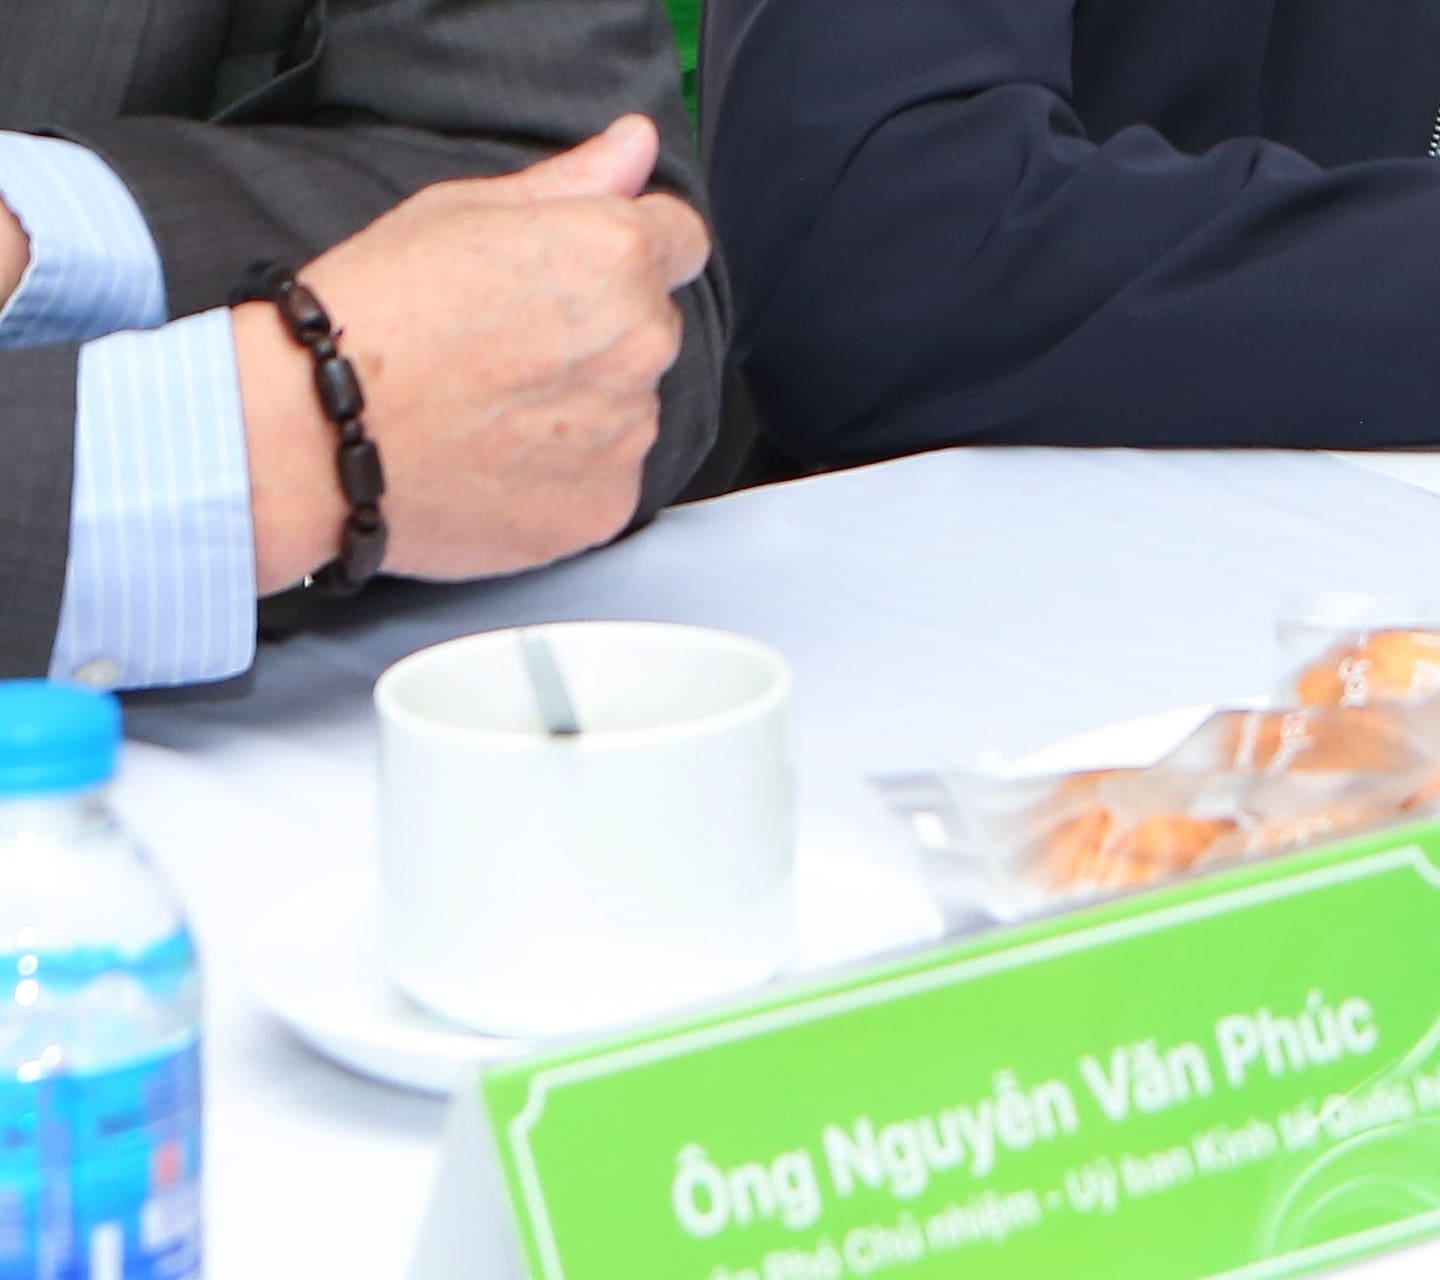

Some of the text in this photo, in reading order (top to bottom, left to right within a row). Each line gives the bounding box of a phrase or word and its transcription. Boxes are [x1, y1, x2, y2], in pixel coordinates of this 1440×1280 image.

[672, 987, 1380, 1238] Ông Nguyễn Văn Phúc
[1119, 1144, 1195, 1198] ban
[1192, 1116, 1280, 1176] Kinh
